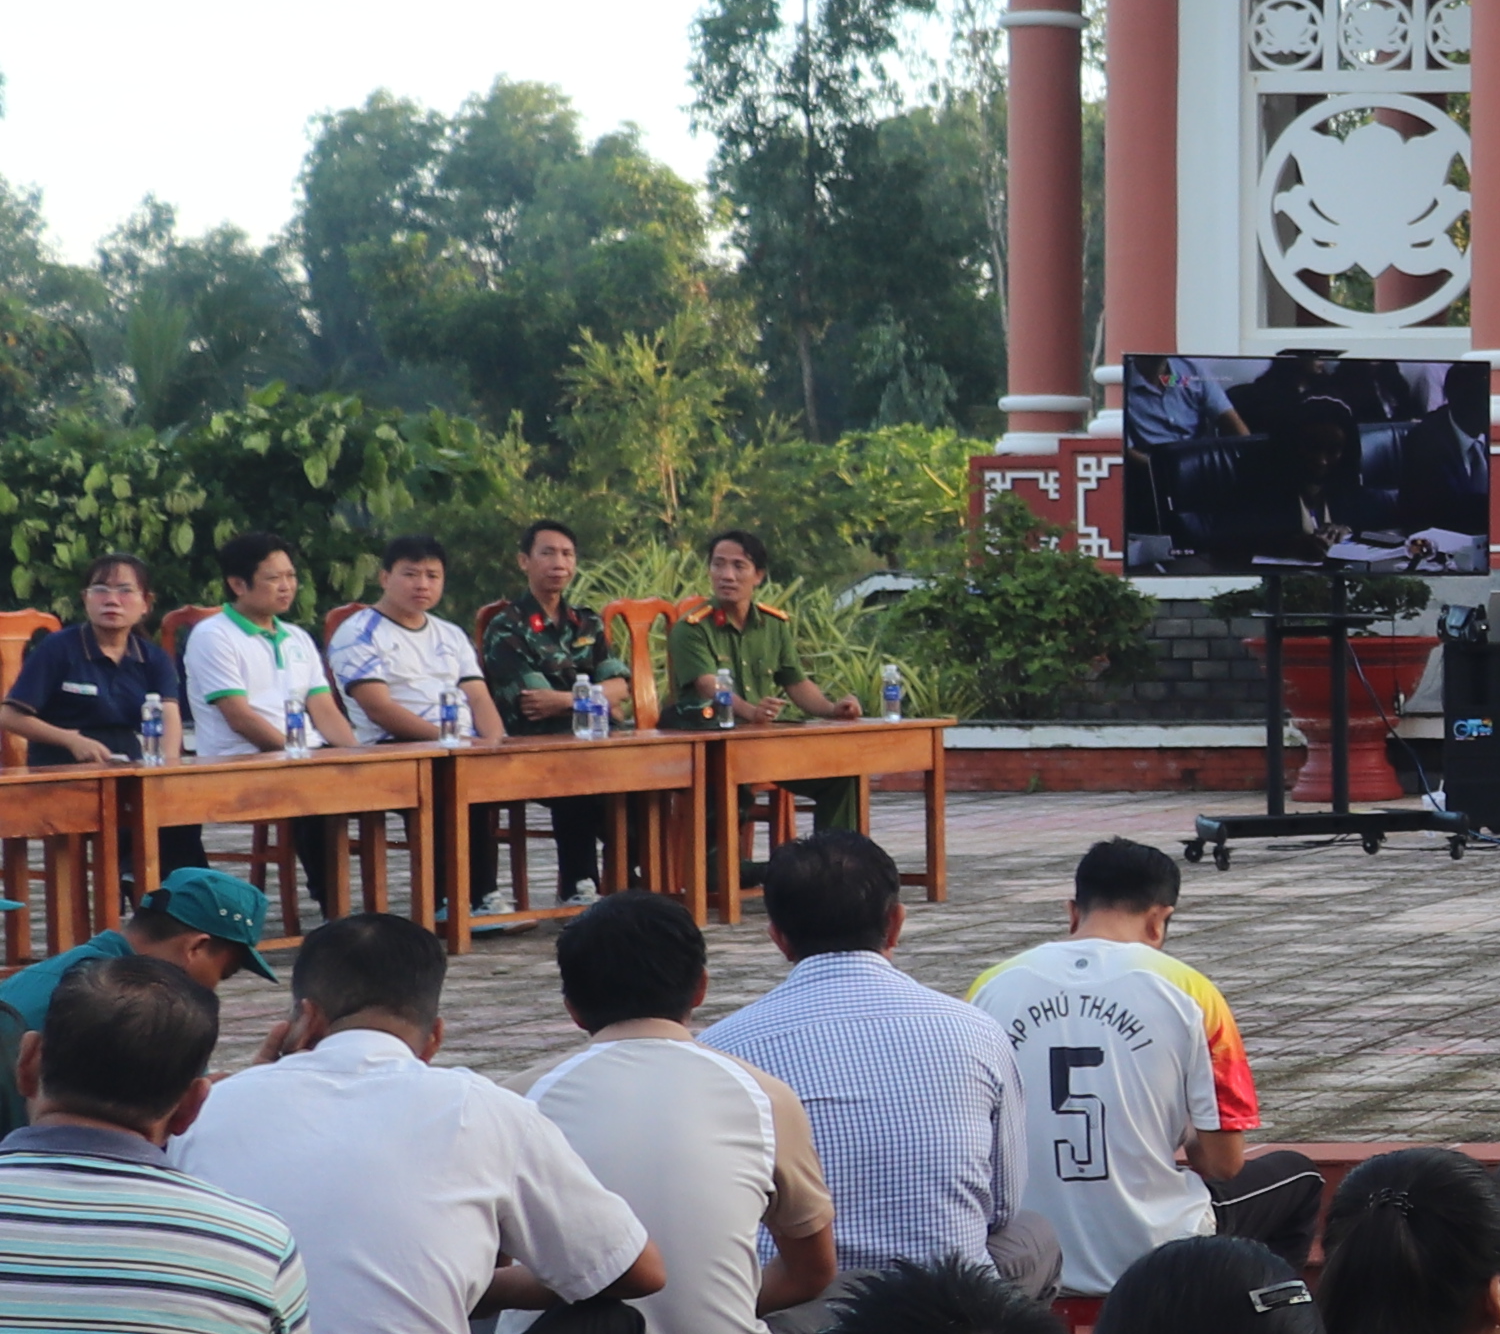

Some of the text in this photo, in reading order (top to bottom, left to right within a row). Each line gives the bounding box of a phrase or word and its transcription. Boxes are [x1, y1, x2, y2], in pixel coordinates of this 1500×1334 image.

[1027, 990, 1070, 1028] PHÚ
[1078, 994, 1145, 1042] THẠNH
[1131, 1038, 1154, 1052] 1
[1048, 1046, 1110, 1182] 5
